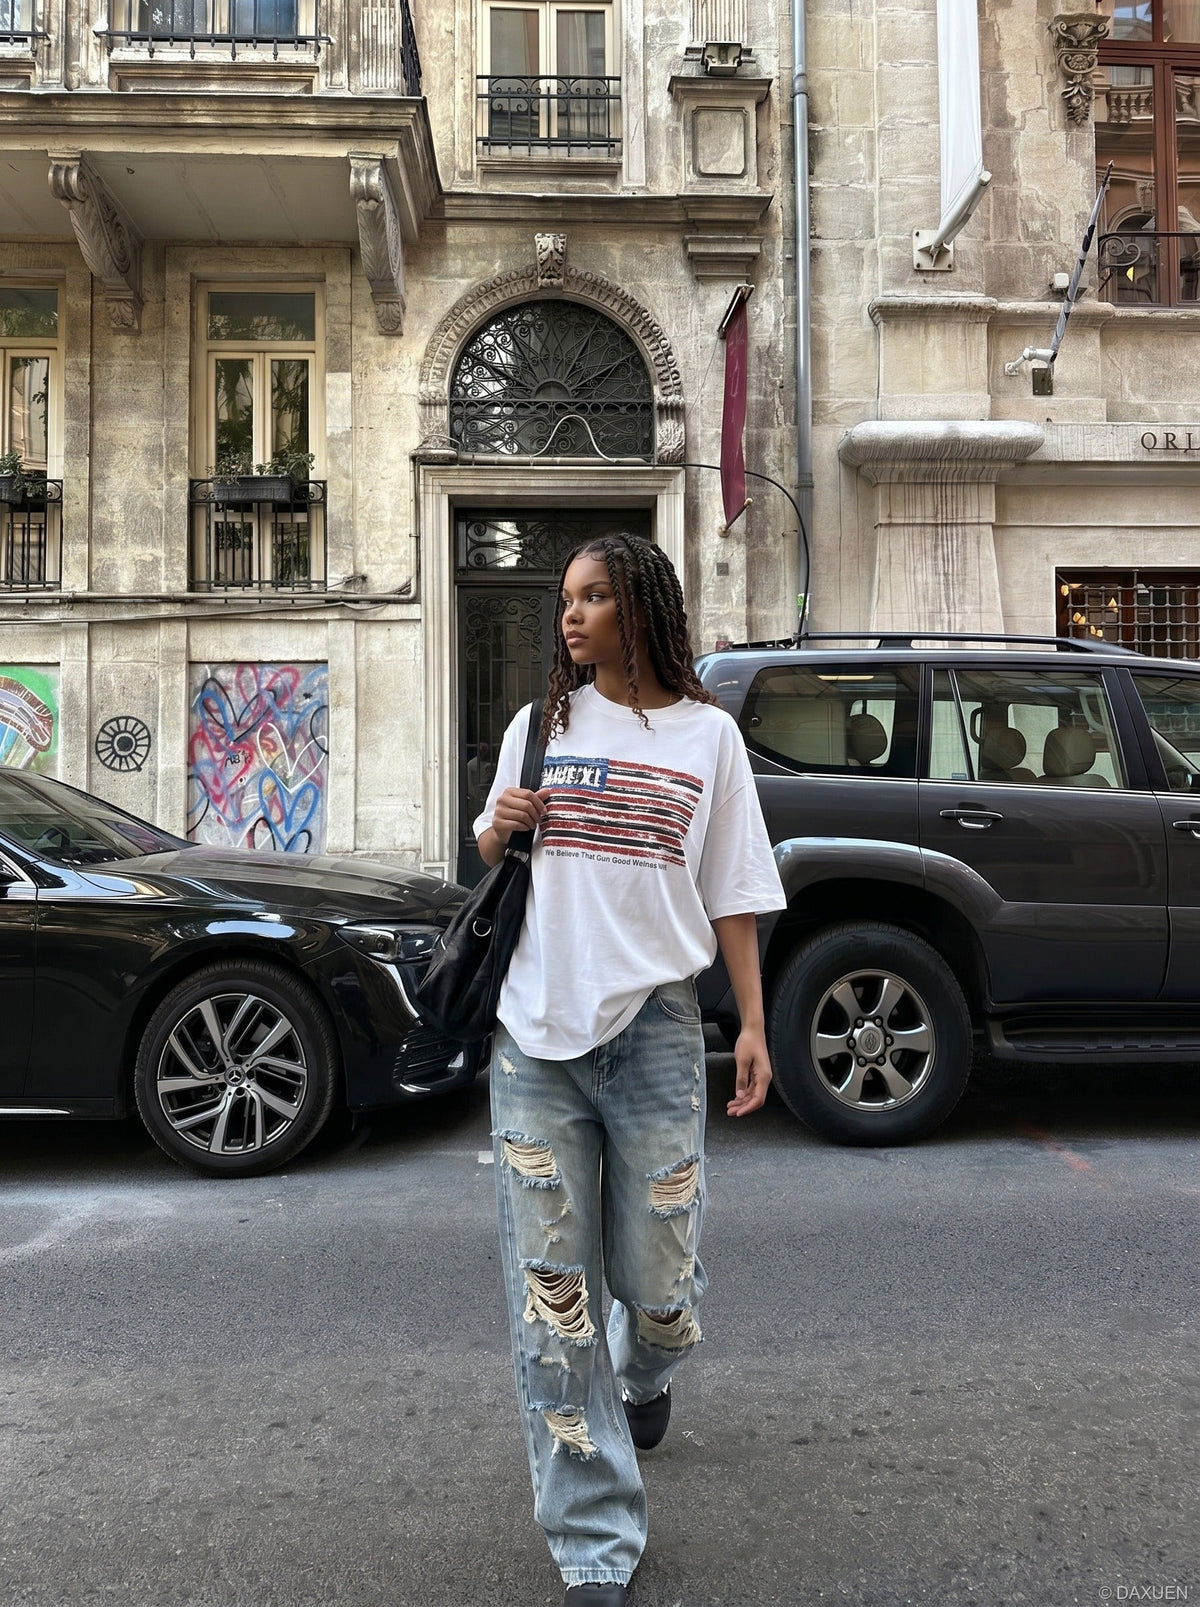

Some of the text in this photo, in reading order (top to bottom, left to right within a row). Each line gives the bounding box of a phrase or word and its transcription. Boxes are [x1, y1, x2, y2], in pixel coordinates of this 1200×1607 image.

[556, 849, 580, 858] Believe
[581, 851, 595, 860] That
[612, 856, 631, 865] Good
